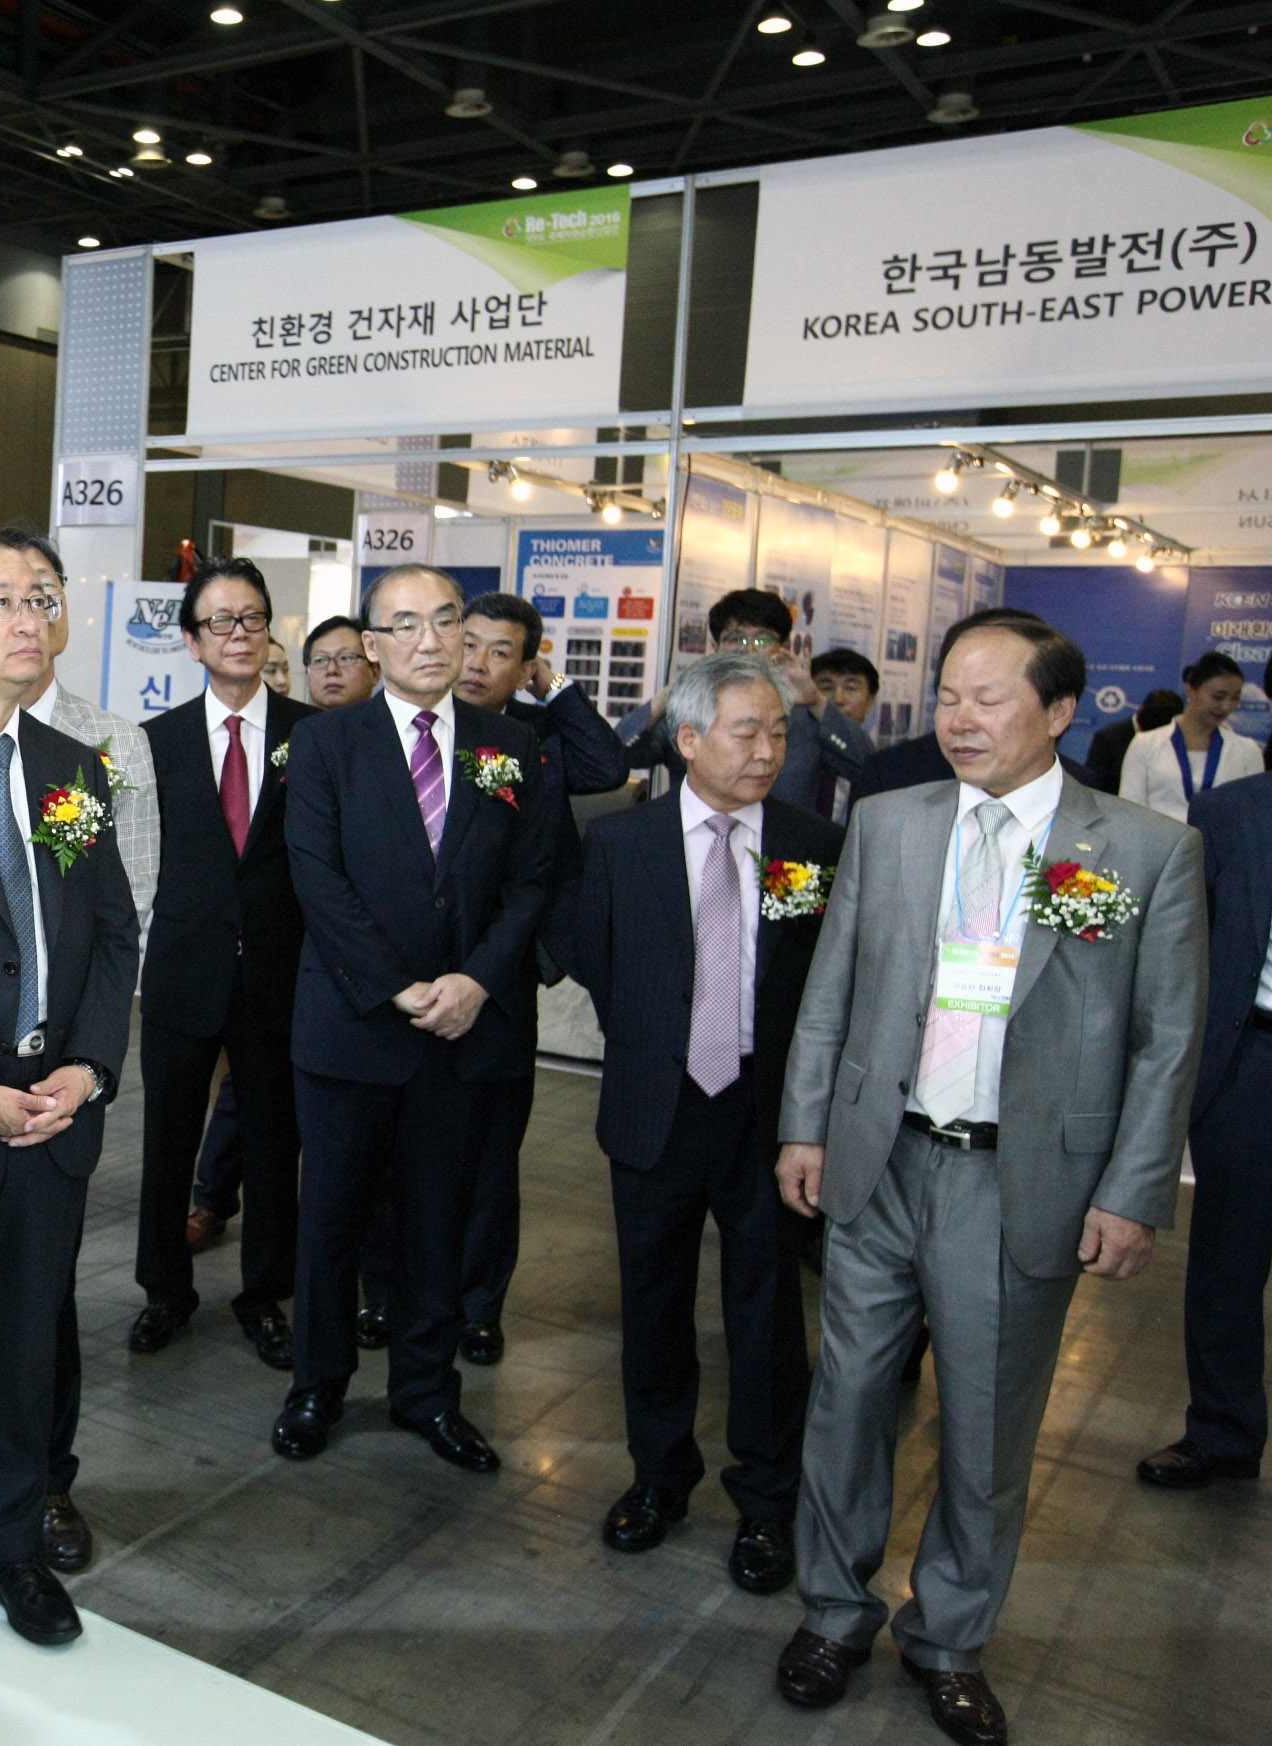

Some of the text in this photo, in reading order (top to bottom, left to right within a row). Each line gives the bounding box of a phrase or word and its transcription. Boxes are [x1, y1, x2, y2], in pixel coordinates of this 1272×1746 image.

[525, 208, 588, 233] Re-Tech
[590, 211, 621, 226] 2016
[881, 221, 1259, 296] 한국남동발전(주)
[251, 290, 548, 349] 친환경 건자재 사업단
[801, 279, 1272, 340] KOREA SOUTH-EAST POWER
[209, 335, 594, 383] CENTER FOR GREEN CONSTRUCTION MATERIAL
[62, 479, 124, 506] A326
[362, 528, 414, 551] A326
[530, 538, 602, 553] THIOMER
[529, 553, 614, 567] CONCRETE
[139, 673, 172, 711] 신
[947, 999, 1001, 1013] EXHIBITOR
